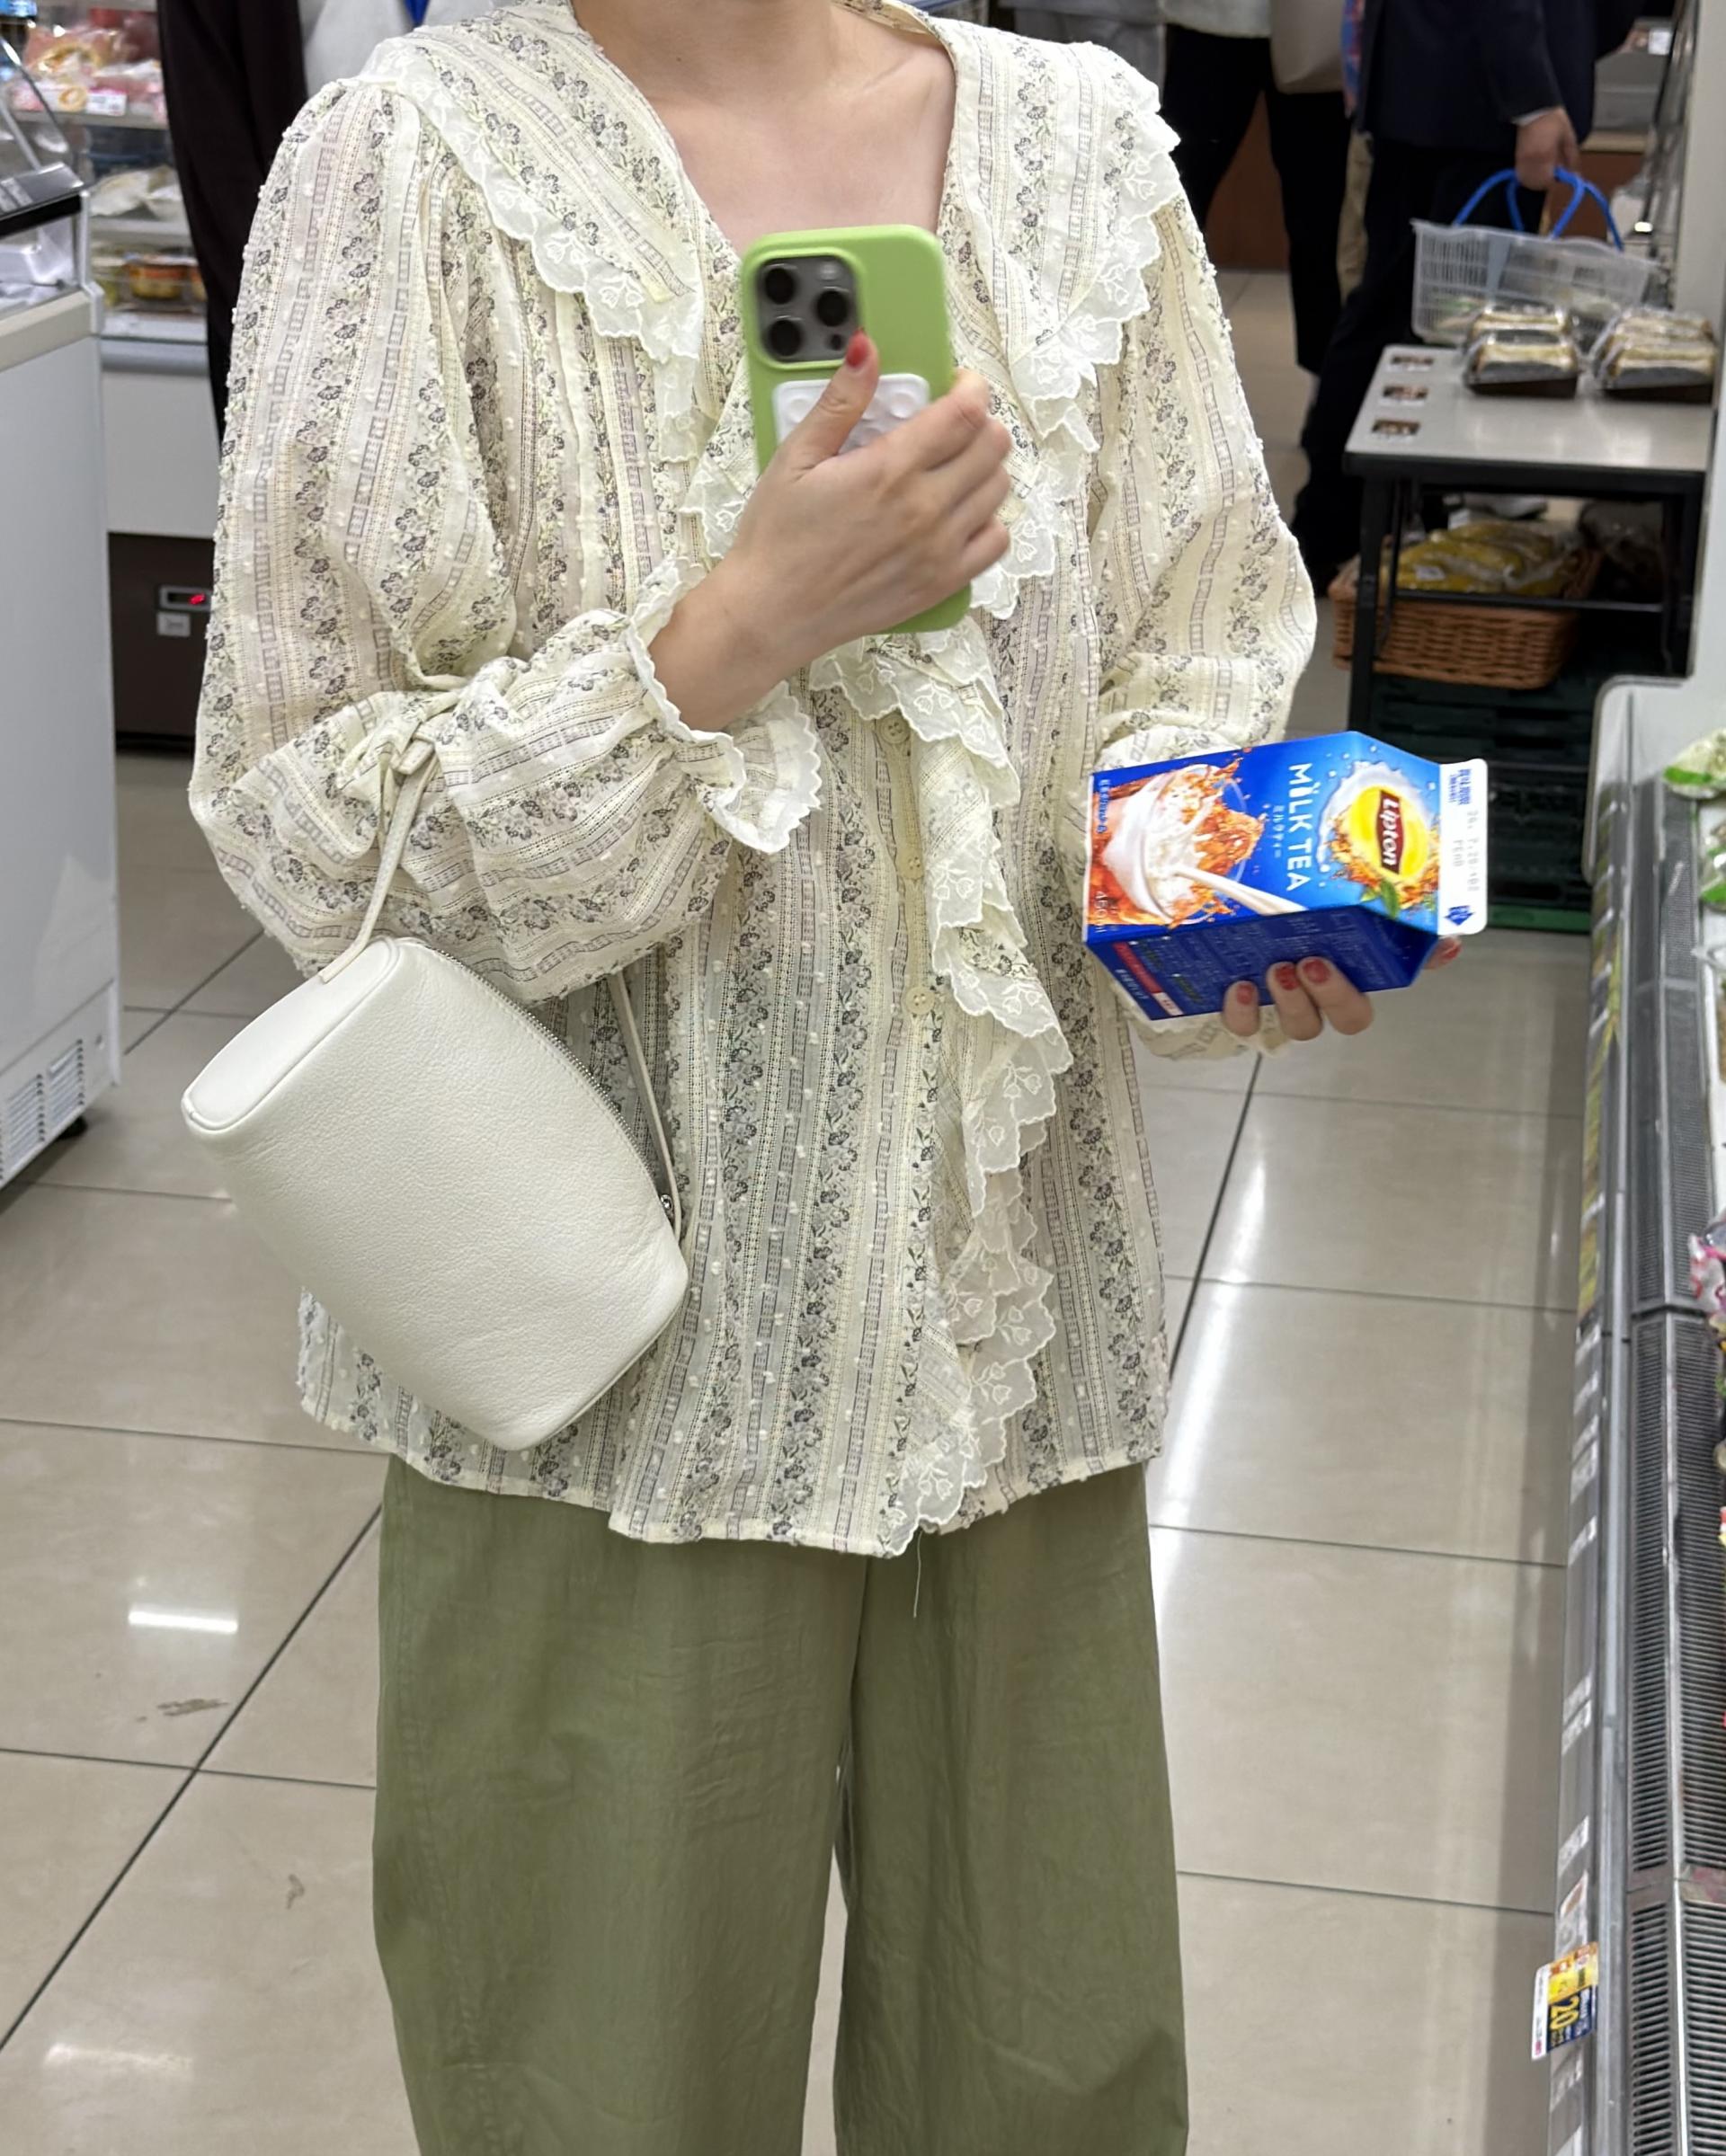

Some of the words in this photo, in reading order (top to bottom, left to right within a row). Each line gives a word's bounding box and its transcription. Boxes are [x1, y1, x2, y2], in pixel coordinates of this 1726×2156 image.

[1288, 762, 1317, 834] MILK
[1379, 798, 1400, 866] Lipton
[1286, 838, 1312, 892] TEA
[1550, 1995, 1580, 2030] 20
